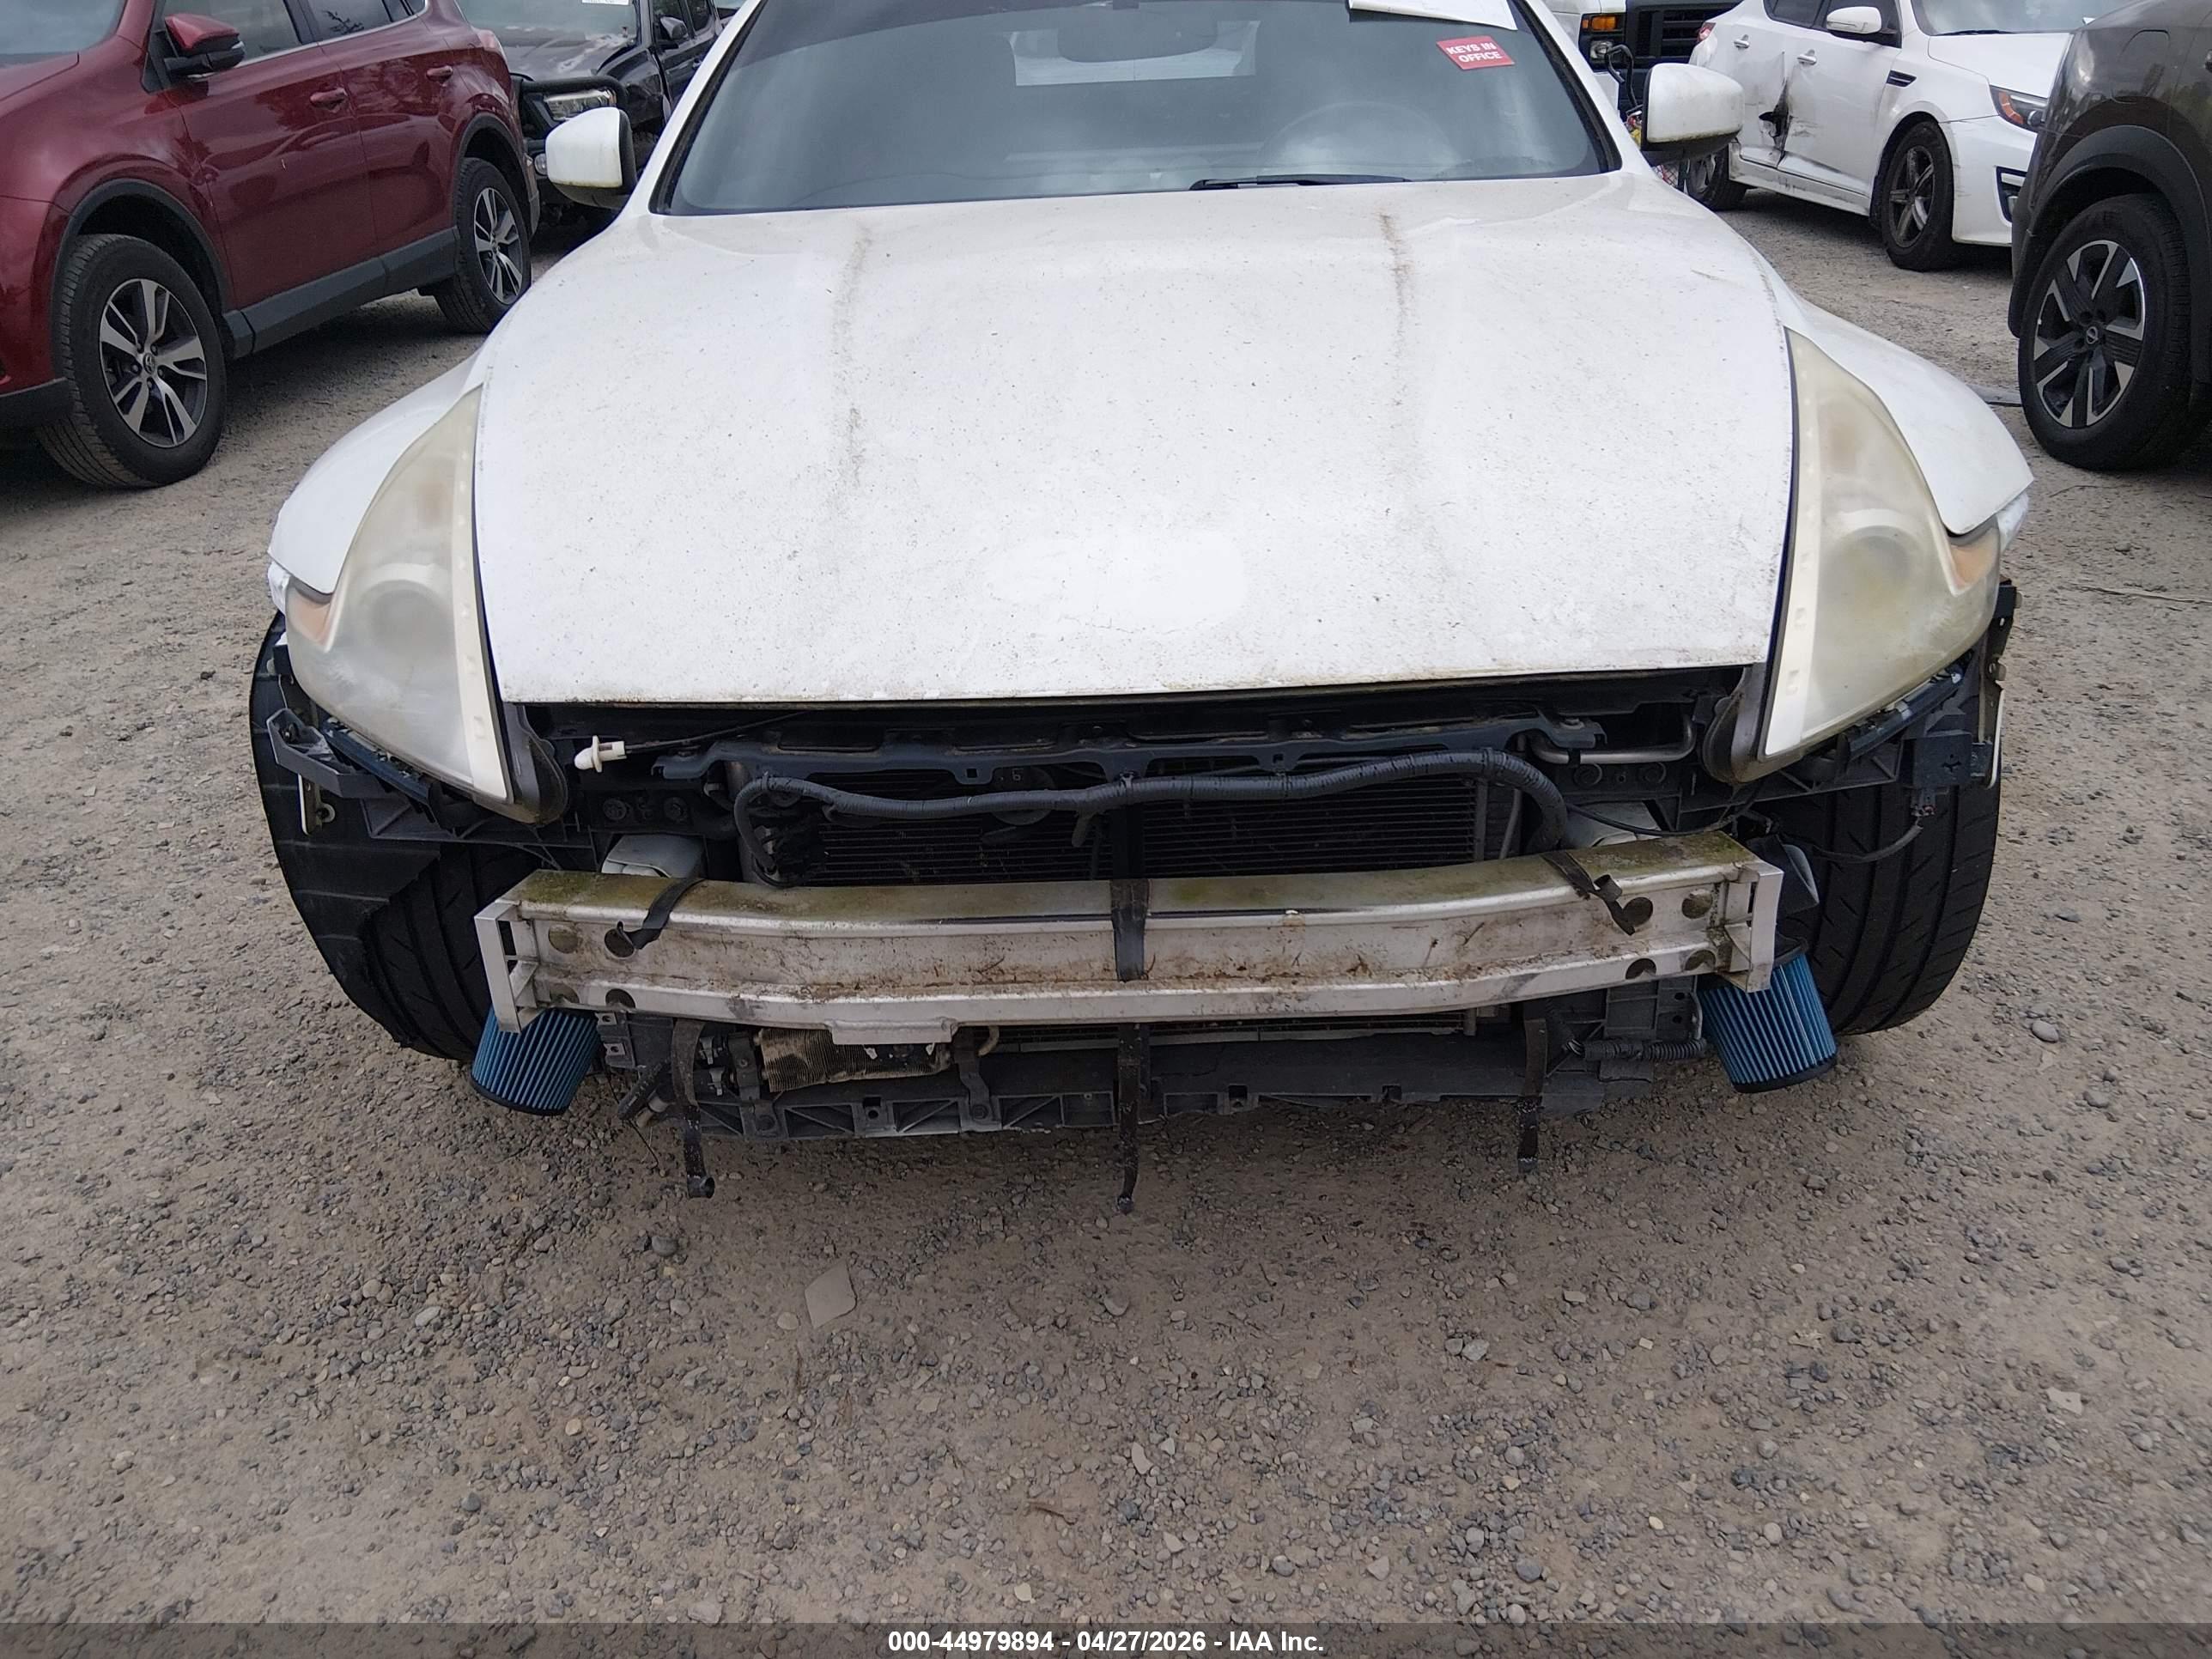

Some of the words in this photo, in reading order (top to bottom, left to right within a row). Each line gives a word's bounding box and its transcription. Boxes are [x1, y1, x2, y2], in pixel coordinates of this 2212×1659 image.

[1446, 44, 1480, 55] KEYS
[1480, 42, 1498, 51] IN
[1458, 52, 1502, 63] OFFICE
